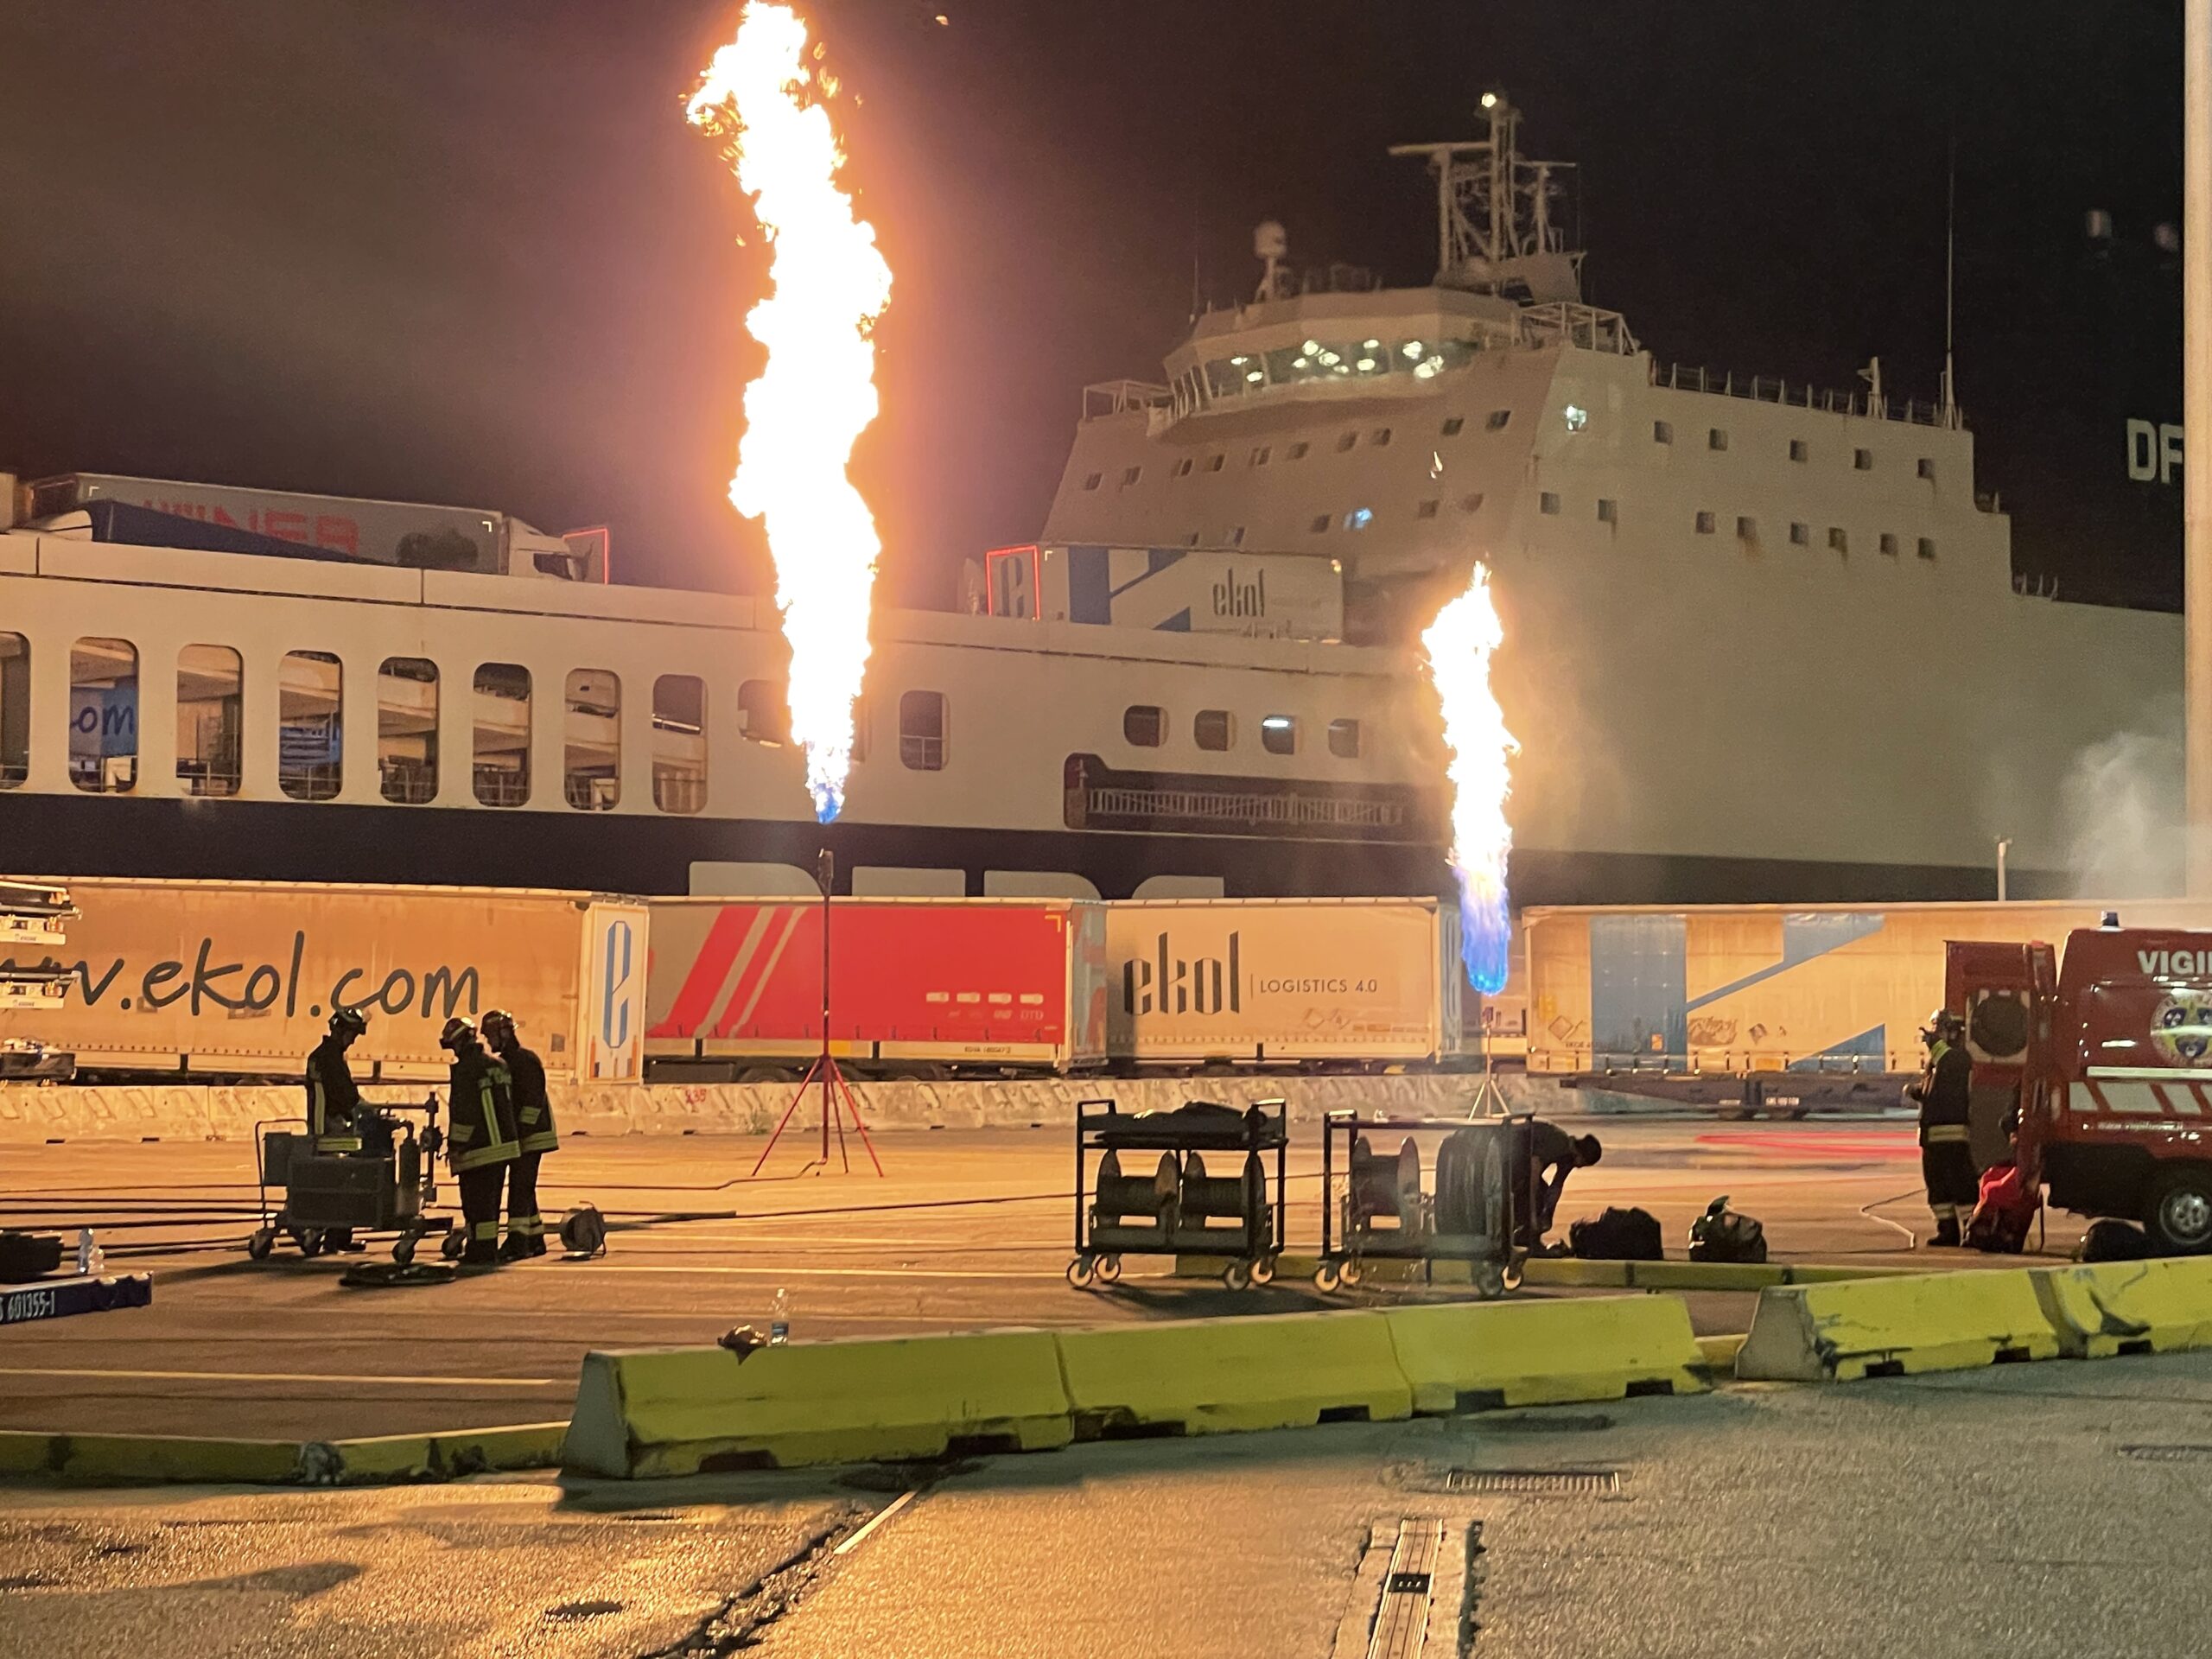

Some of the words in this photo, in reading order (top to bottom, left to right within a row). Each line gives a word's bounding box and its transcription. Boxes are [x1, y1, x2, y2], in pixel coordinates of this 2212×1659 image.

[2126, 418, 2184, 484] DF
[71, 704, 134, 735] om
[1124, 930, 1239, 1015] ekol
[1260, 979, 1348, 994] LOGISTICS
[1355, 978, 1378, 993] 4.0
